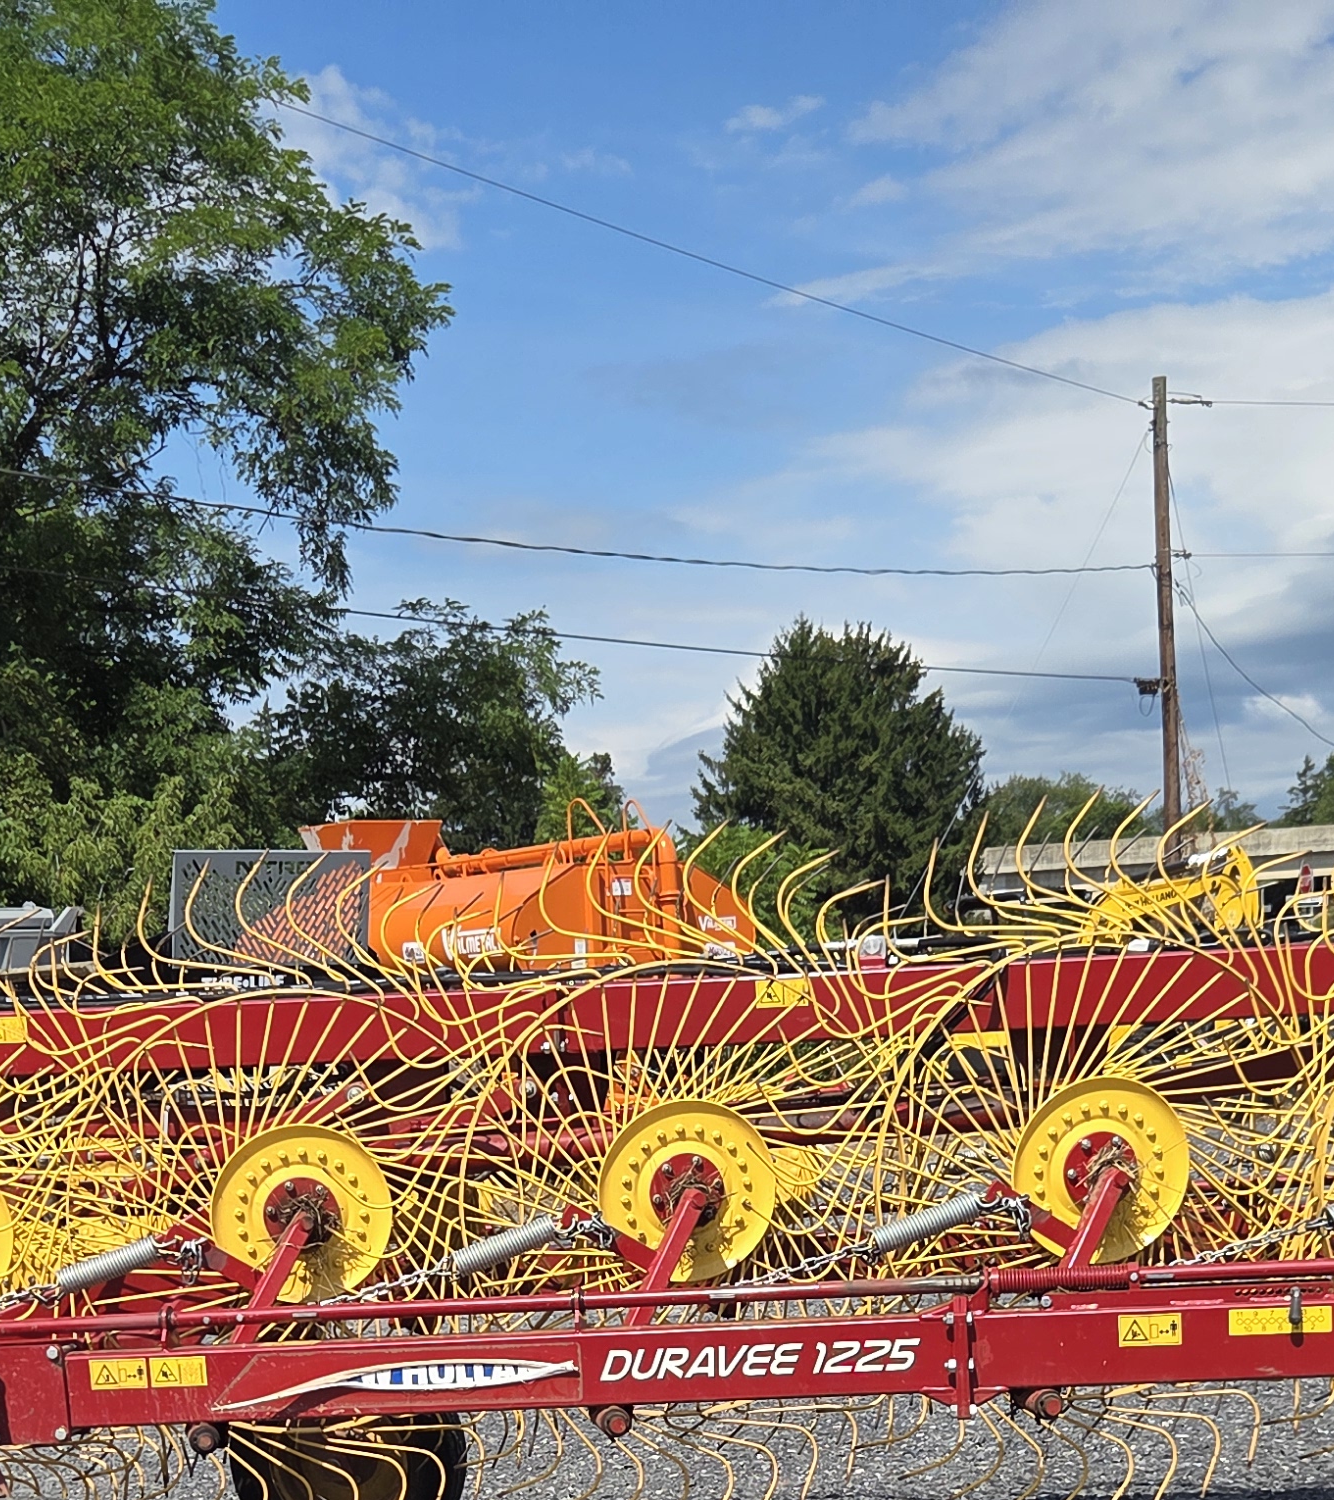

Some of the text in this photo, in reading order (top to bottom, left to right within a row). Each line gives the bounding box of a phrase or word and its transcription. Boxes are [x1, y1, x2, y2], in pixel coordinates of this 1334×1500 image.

[236, 861, 314, 875] NTRO
[599, 1338, 921, 1382] DURAVEE 1225
